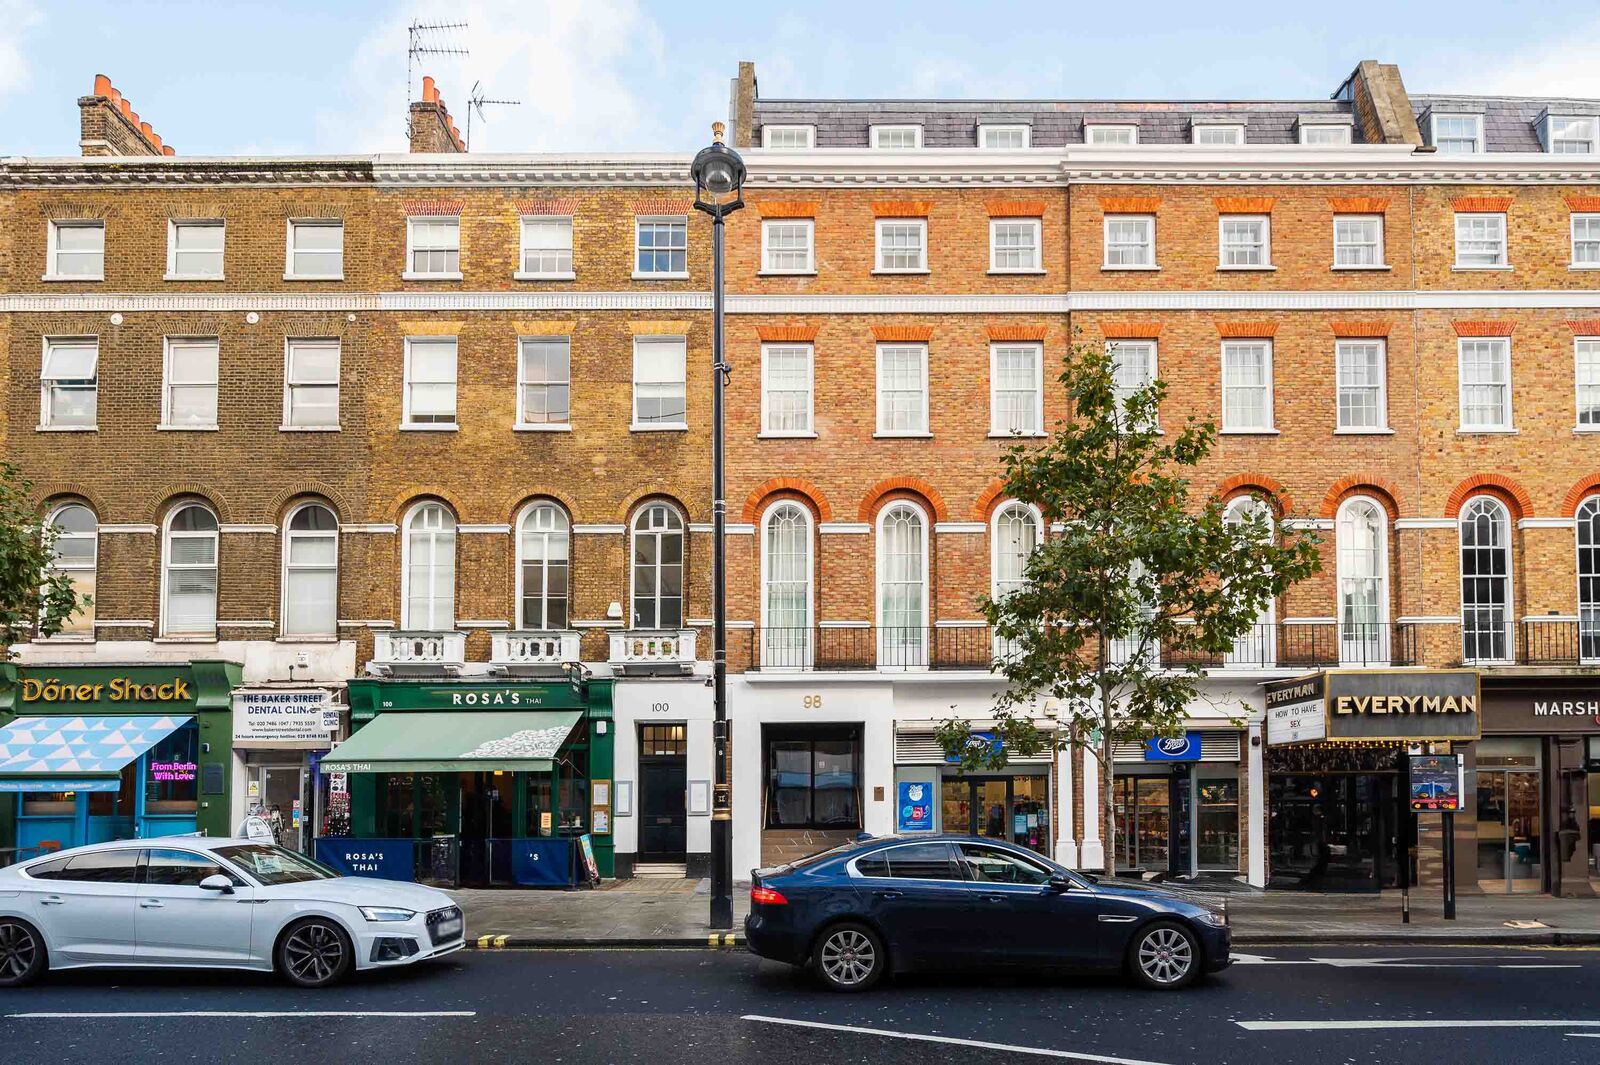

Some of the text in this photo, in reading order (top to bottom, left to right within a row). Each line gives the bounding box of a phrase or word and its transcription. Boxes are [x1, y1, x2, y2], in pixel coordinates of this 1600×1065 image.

[21, 678, 191, 701] Döner Shack
[1266, 683, 1314, 704] EVERYMAN
[243, 695, 322, 703] THE BAKER STREET
[453, 690, 519, 704] ROSA'S
[804, 696, 821, 708] 98
[1338, 696, 1476, 714] EVERYMAN
[248, 706, 282, 714] DENTAL
[652, 703, 669, 712] 100
[1275, 704, 1317, 719] HOW TO HAVE
[1534, 702, 1599, 715] MARSH
[323, 711, 338, 719] DENTAL
[323, 719, 338, 727] CLINIC
[1290, 719, 1301, 728] SEX
[151, 762, 197, 770] From Berlin
[154, 772, 195, 780] With Love
[352, 863, 378, 871] THAI
